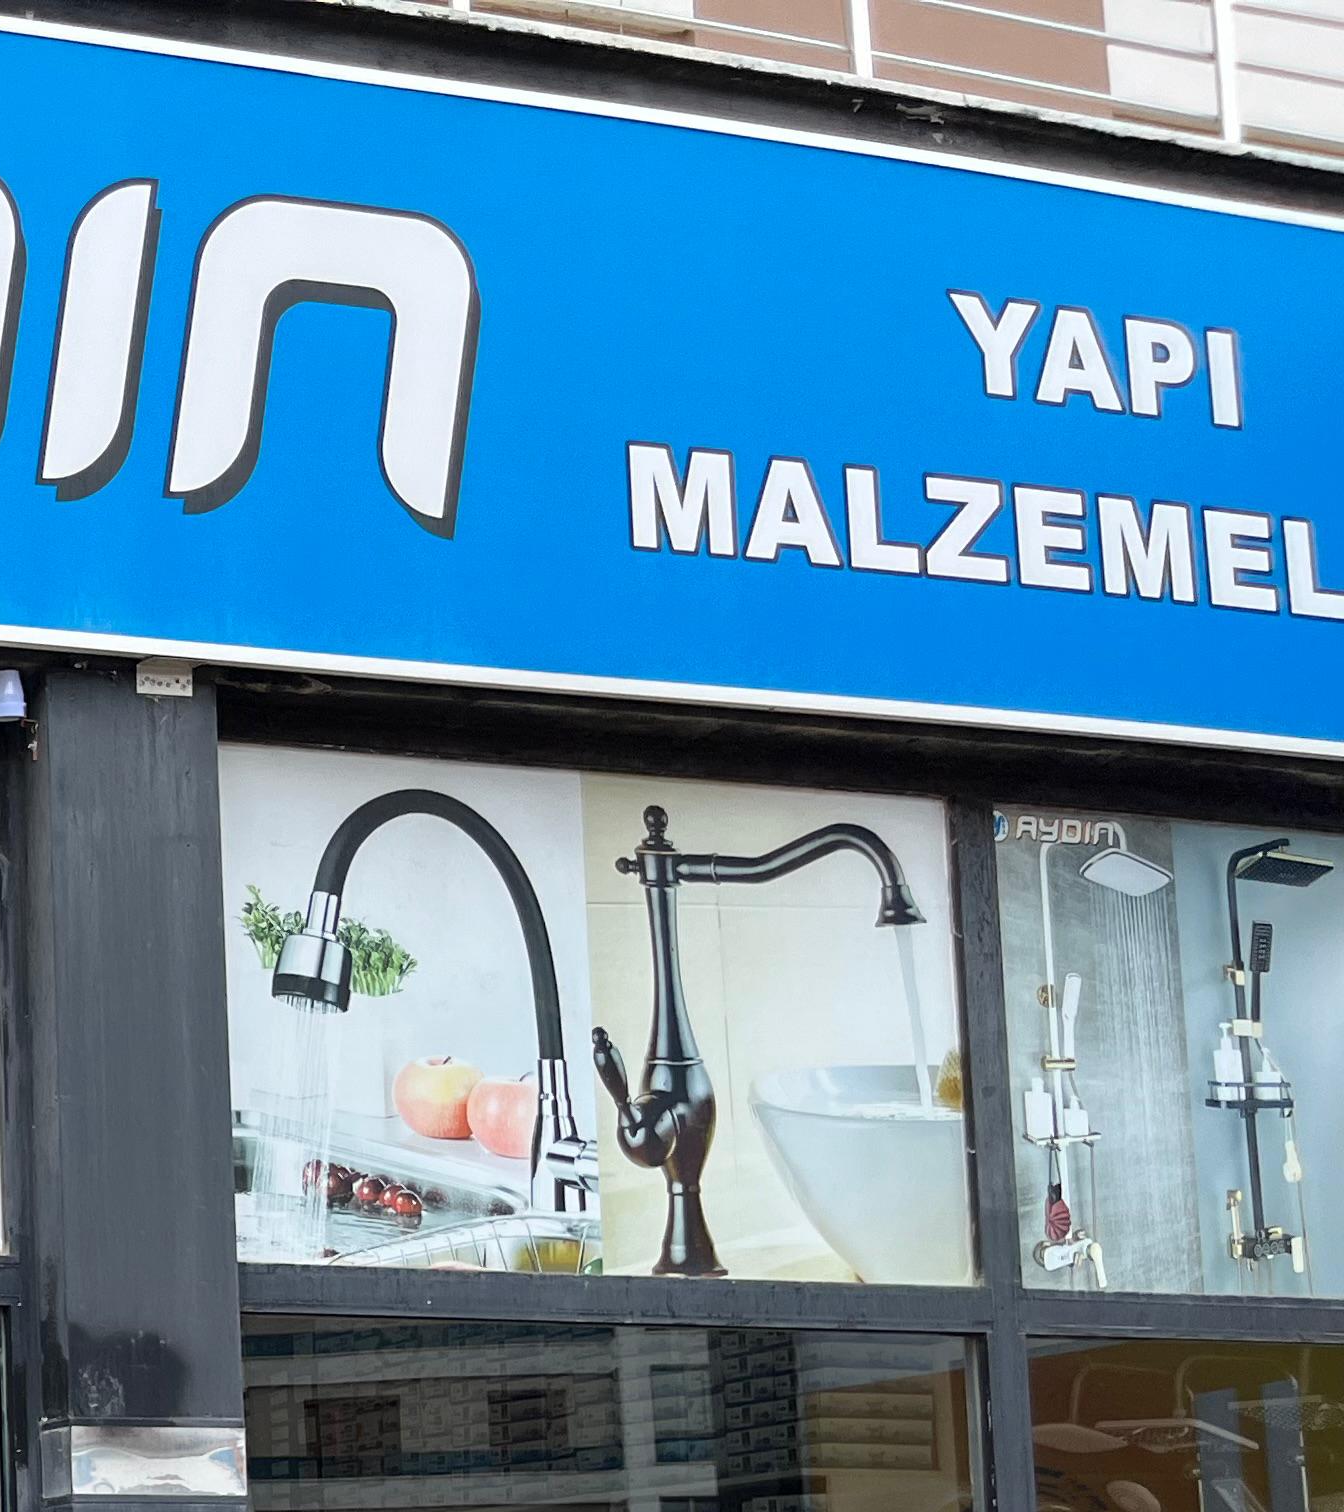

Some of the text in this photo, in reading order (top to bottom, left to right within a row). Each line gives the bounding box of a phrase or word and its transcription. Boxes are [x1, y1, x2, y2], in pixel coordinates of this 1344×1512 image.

[946, 288, 1245, 430] YAPI
[626, 442, 1344, 621] MALZEMEL
[1016, 815, 1114, 846] AYDIN
